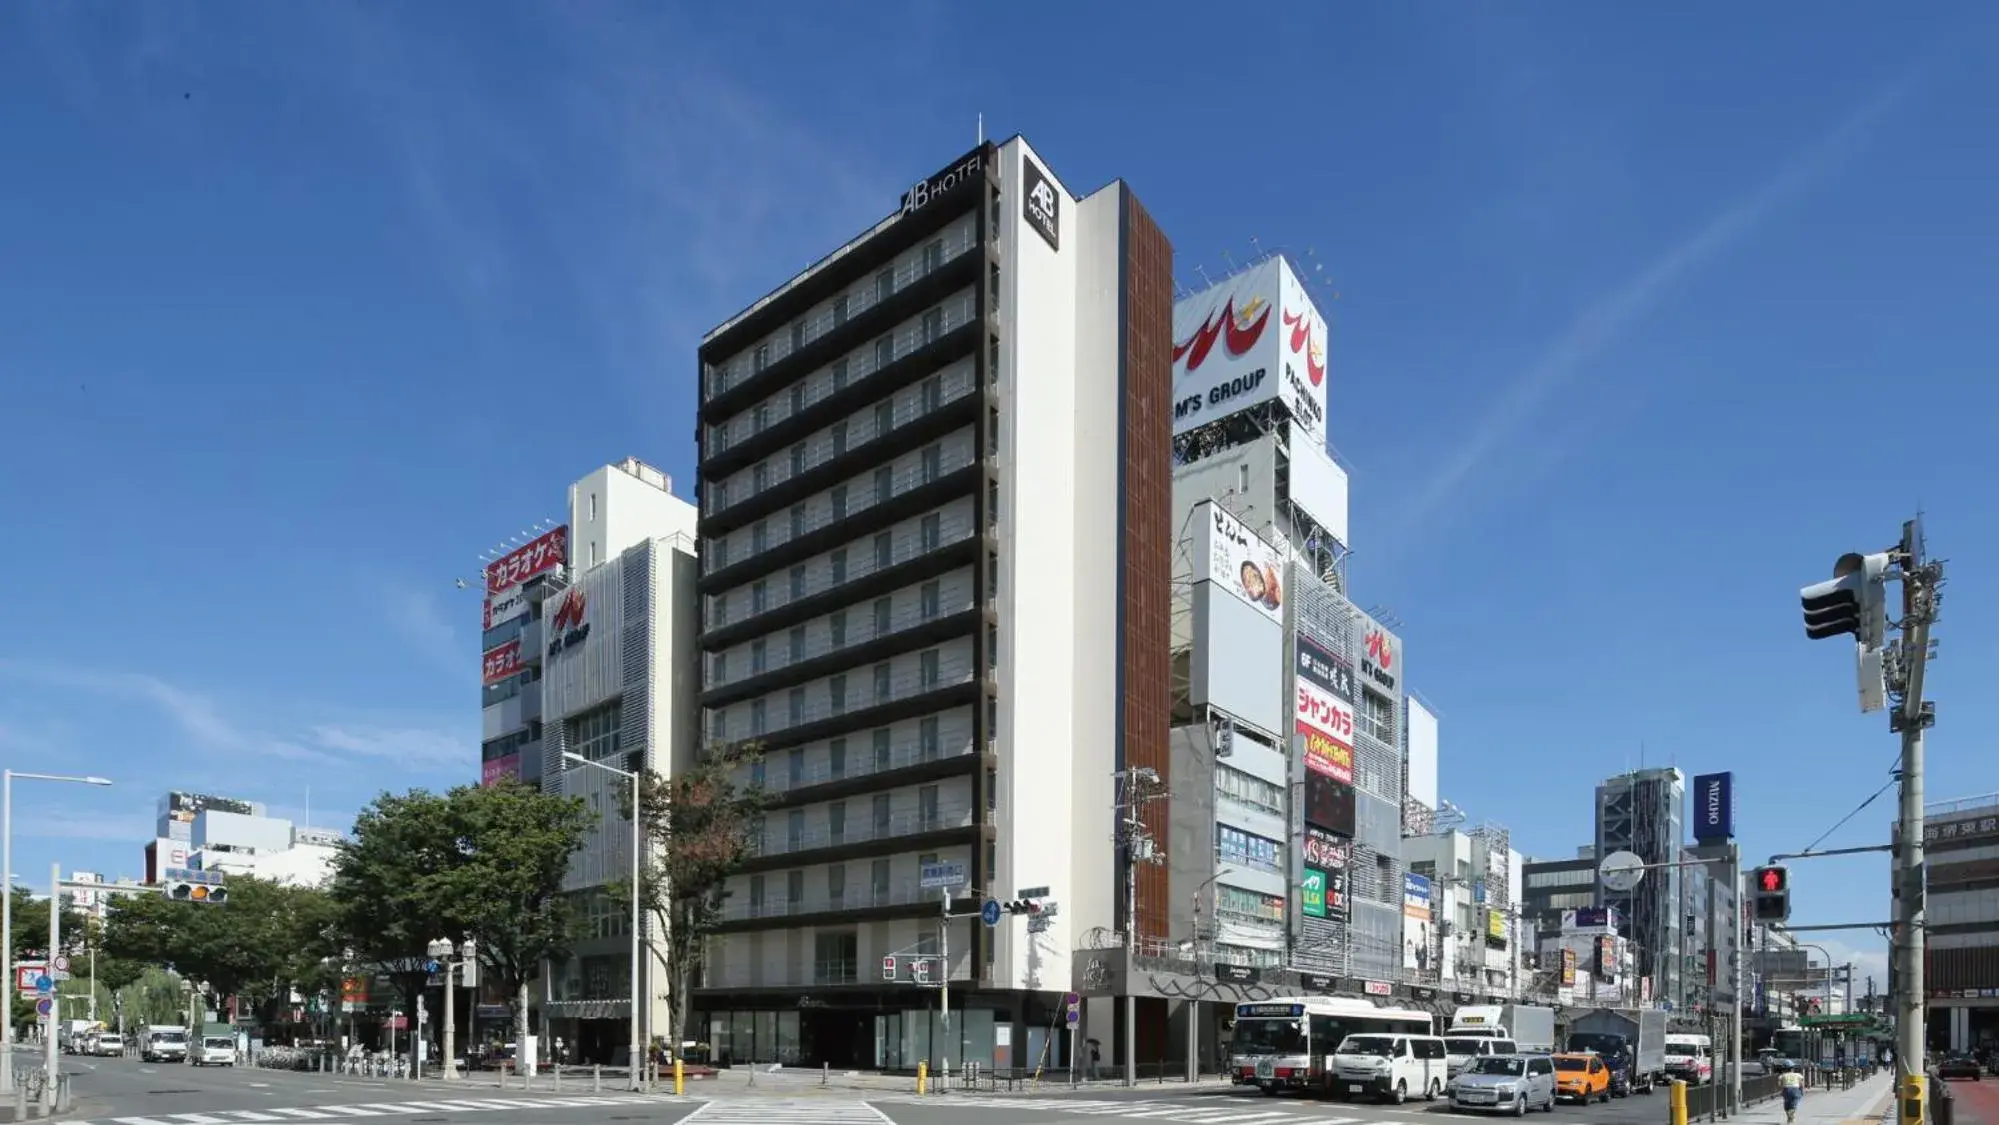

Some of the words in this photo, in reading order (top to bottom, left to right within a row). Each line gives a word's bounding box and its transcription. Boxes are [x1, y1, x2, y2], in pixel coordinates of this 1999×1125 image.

[900, 178, 928, 216] AB
[1029, 198, 1057, 238] HOTEL
[1030, 179, 1054, 218] AB
[1175, 394, 1202, 419] M'S
[1209, 368, 1266, 405] GROUP
[1285, 361, 1322, 424] PACHINKO
[1709, 780, 1720, 825] MIZUHO
